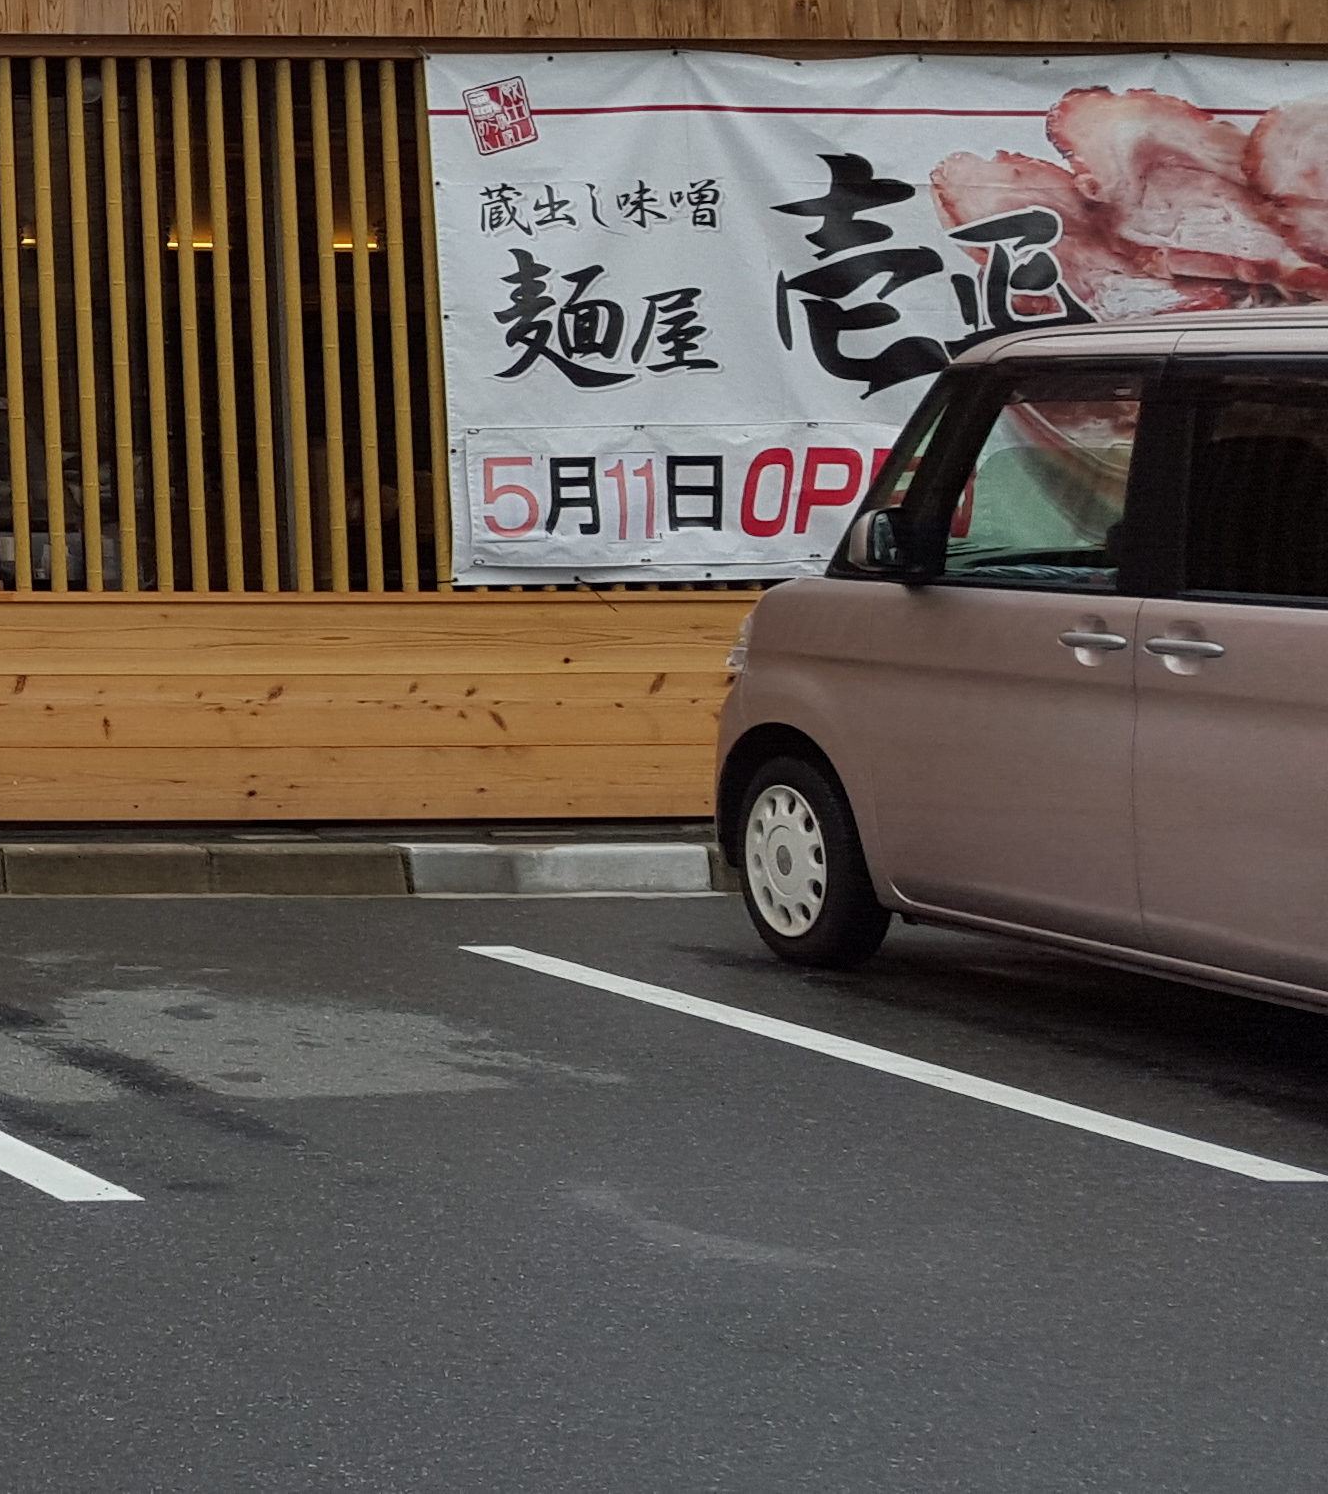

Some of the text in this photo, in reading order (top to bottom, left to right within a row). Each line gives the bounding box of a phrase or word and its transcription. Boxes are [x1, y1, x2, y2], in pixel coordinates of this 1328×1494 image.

[480, 179, 721, 237] 蔵出し味噌
[492, 248, 720, 388] 麺屋
[482, 454, 724, 541] 5月11日
